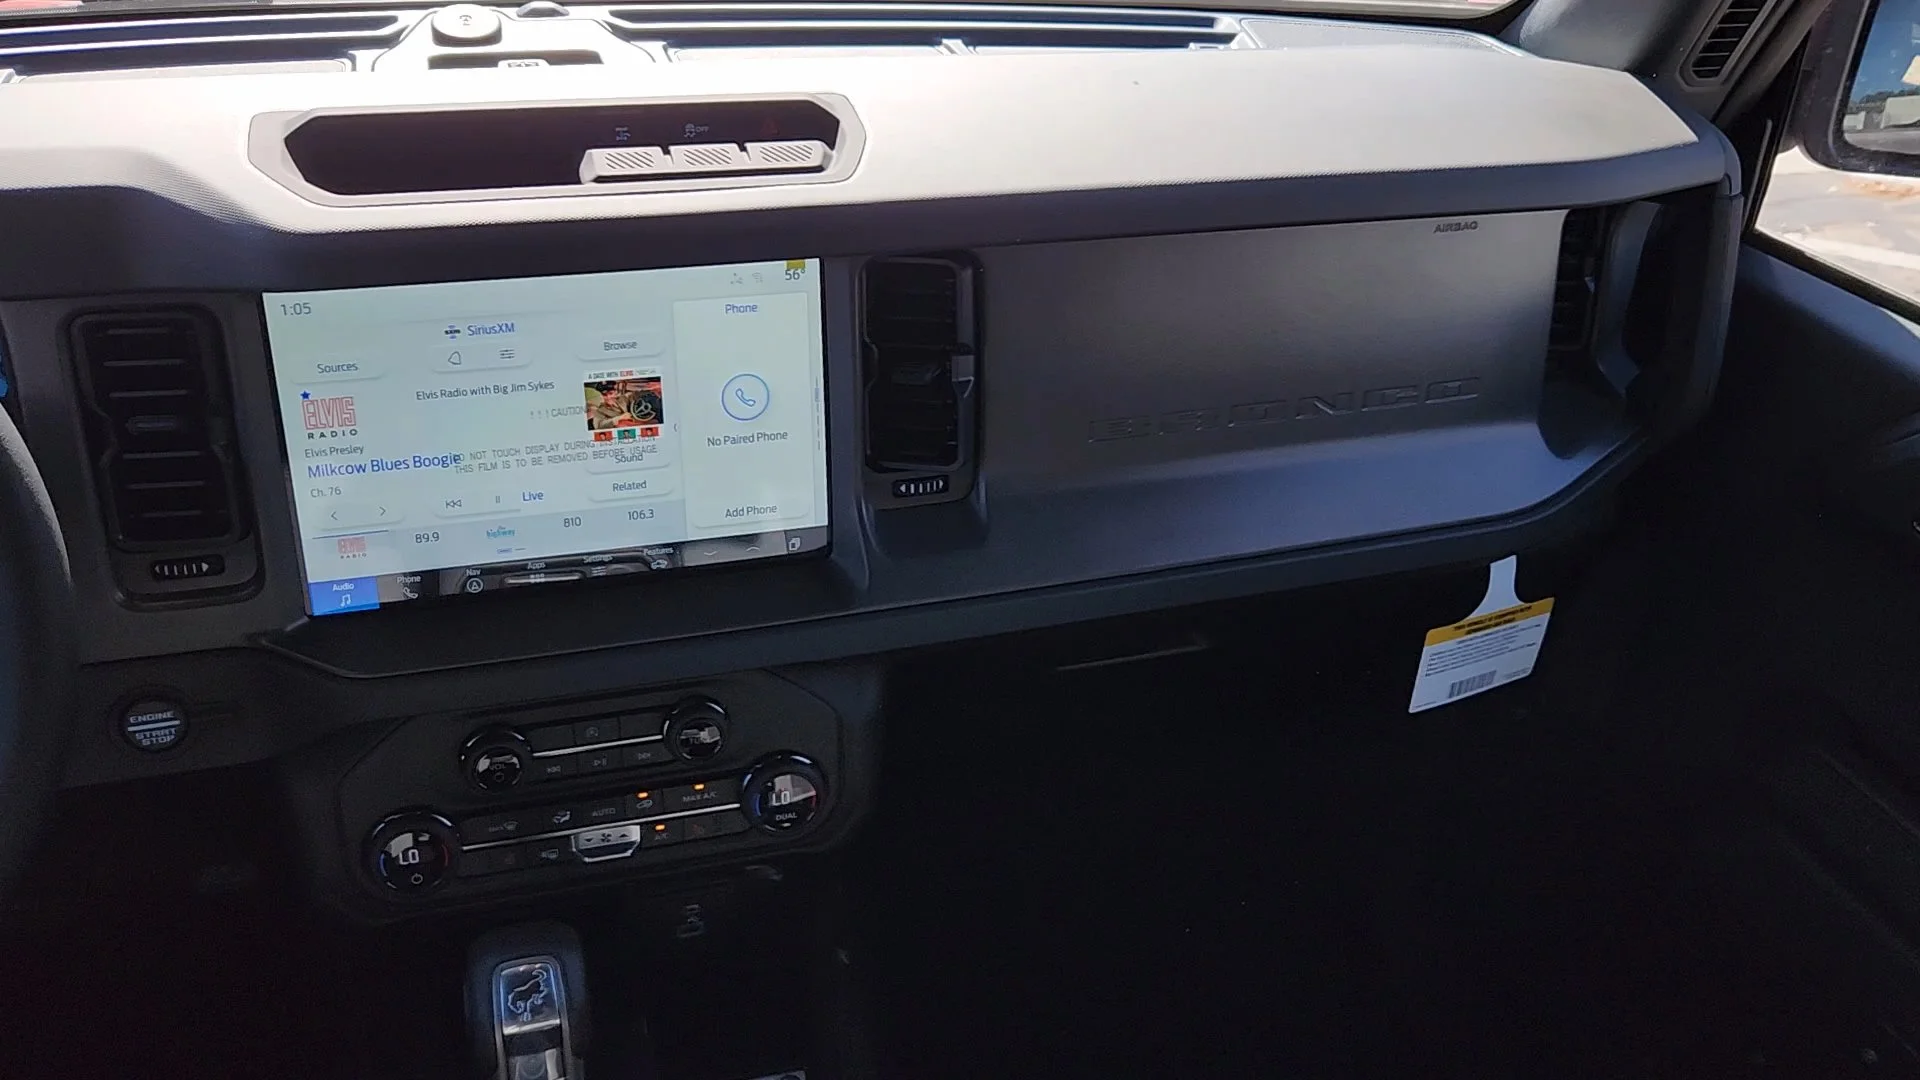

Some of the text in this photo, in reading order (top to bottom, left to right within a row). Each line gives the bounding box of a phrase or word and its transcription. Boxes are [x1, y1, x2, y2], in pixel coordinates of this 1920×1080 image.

[1434, 221, 1478, 233] AIRBAG
[280, 302, 312, 316] 1:05
[725, 303, 758, 314] Phone
[467, 322, 515, 336] SiriusXM
[603, 339, 637, 351] Browse
[317, 360, 358, 374] Sources
[416, 380, 555, 400] Elvis Radio with Big Jim Sykes
[302, 396, 357, 431] ELVIS
[1089, 377, 1481, 443] BRONCO
[307, 428, 358, 440] RADIO
[707, 430, 788, 447] No Paired Phone
[305, 444, 364, 458] Elvis Presley
[470, 450, 487, 460] NOT
[492, 448, 521, 459] TOUCH
[525, 443, 560, 455] DISPLAY
[564, 439, 595, 451] DURING
[454, 444, 657, 474] THIS FILM IS TO BE REMOVED BEFORE USAGE
[615, 453, 643, 463] Sound
[308, 452, 461, 478] Milkcow Blues Boogie
[310, 486, 341, 498] Ch. 76
[612, 480, 647, 492] Related
[522, 490, 544, 502] Live
[627, 508, 655, 521] 106.3
[725, 504, 778, 519] Add Phone
[563, 516, 582, 528] 810
[415, 531, 440, 544] 89.9
[643, 547, 674, 556] Features
[528, 561, 546, 570] Apps
[583, 555, 613, 564] Settings
[465, 567, 481, 577] Nav
[396, 573, 421, 584] Phone
[332, 582, 355, 592] Audio
[130, 711, 174, 723] ENGINE
[142, 735, 175, 745] STOP
[592, 807, 616, 817] AUTO
[775, 812, 798, 821] DUAL
